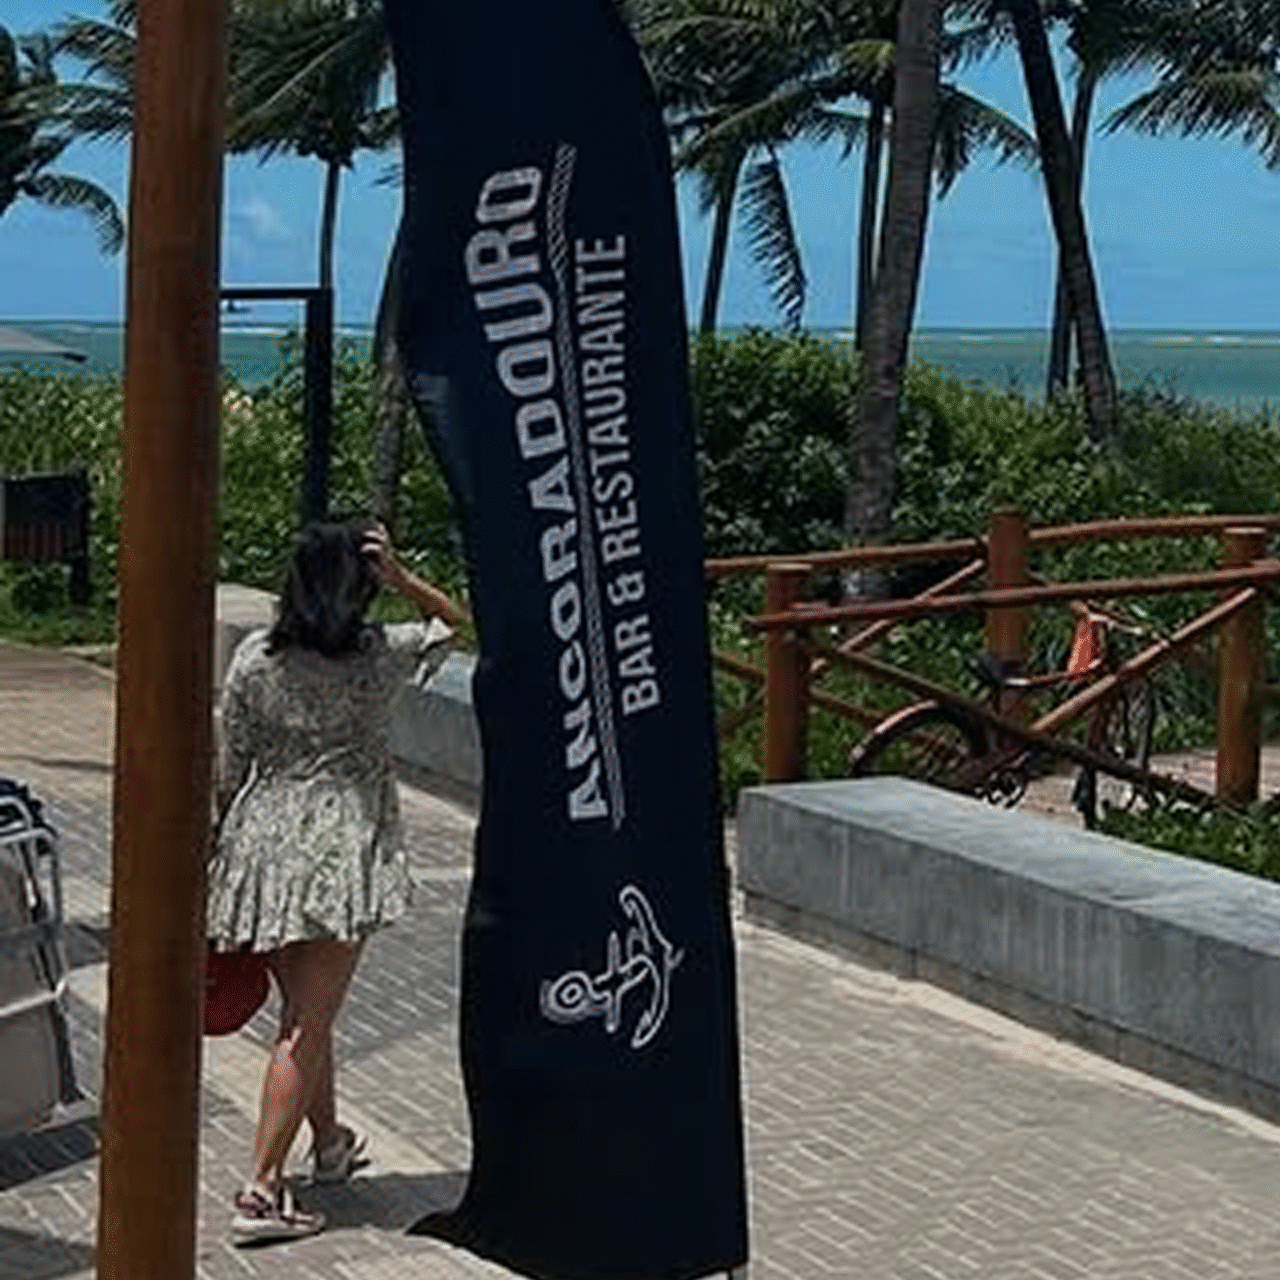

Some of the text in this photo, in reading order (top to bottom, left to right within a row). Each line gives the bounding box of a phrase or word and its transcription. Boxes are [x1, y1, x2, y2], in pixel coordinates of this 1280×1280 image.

[464, 165, 609, 820] ANCORADOURO
[574, 234, 661, 716] BAR & RESTAURANTE
